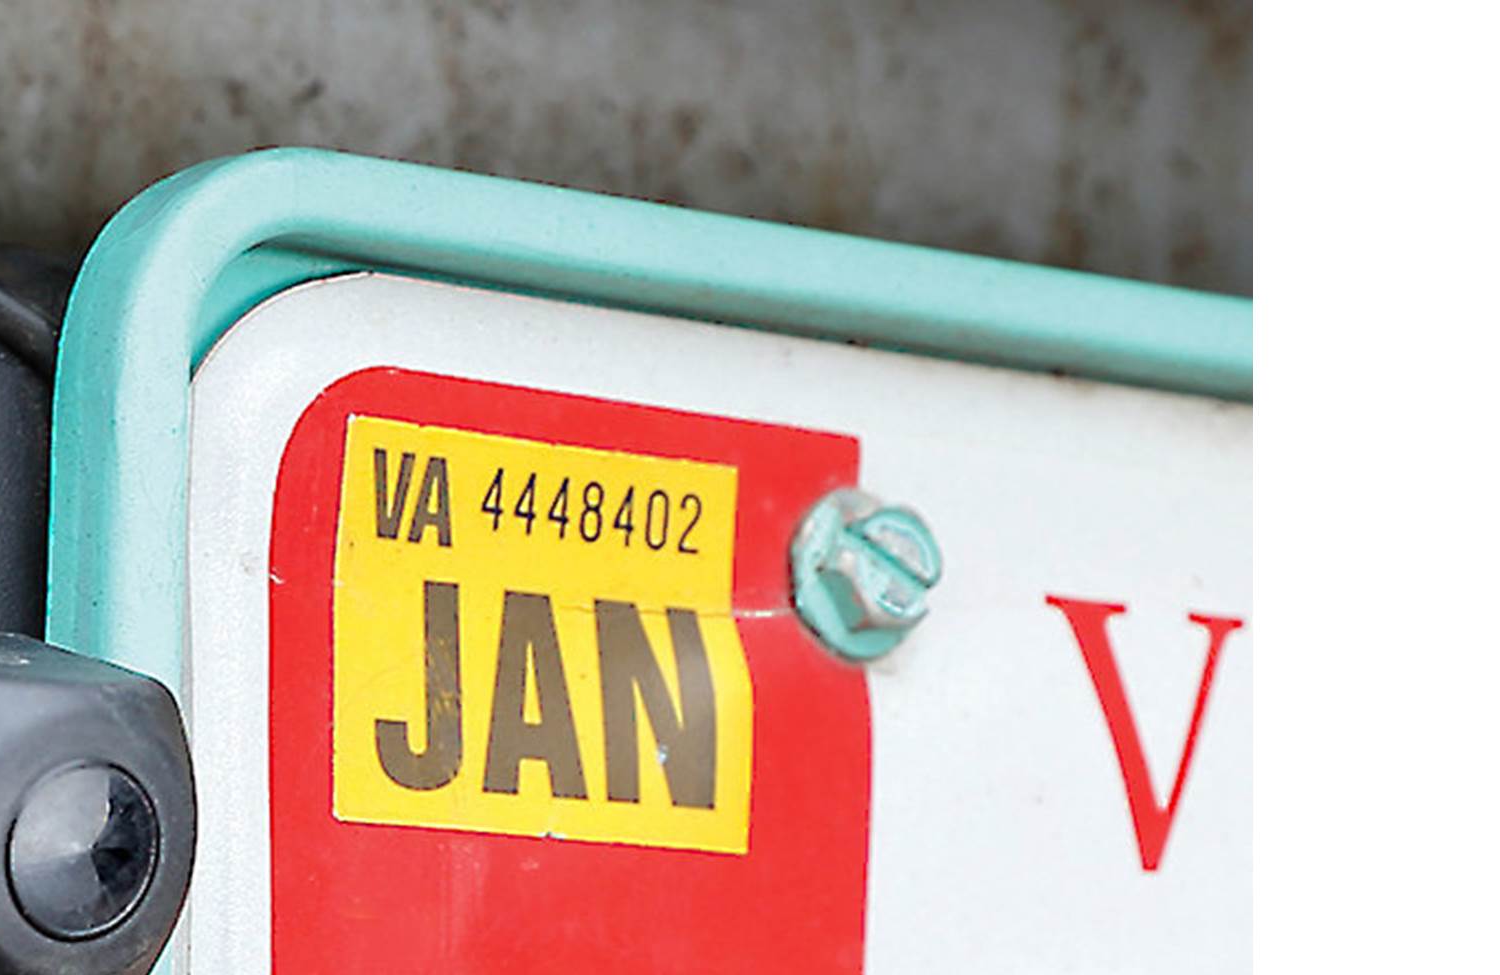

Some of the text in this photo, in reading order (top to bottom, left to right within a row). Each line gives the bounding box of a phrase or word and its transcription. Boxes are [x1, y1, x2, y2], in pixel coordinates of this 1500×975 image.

[373, 447, 703, 554] VA 4448402
[374, 580, 717, 811] JAN
[1044, 594, 1244, 871] V
